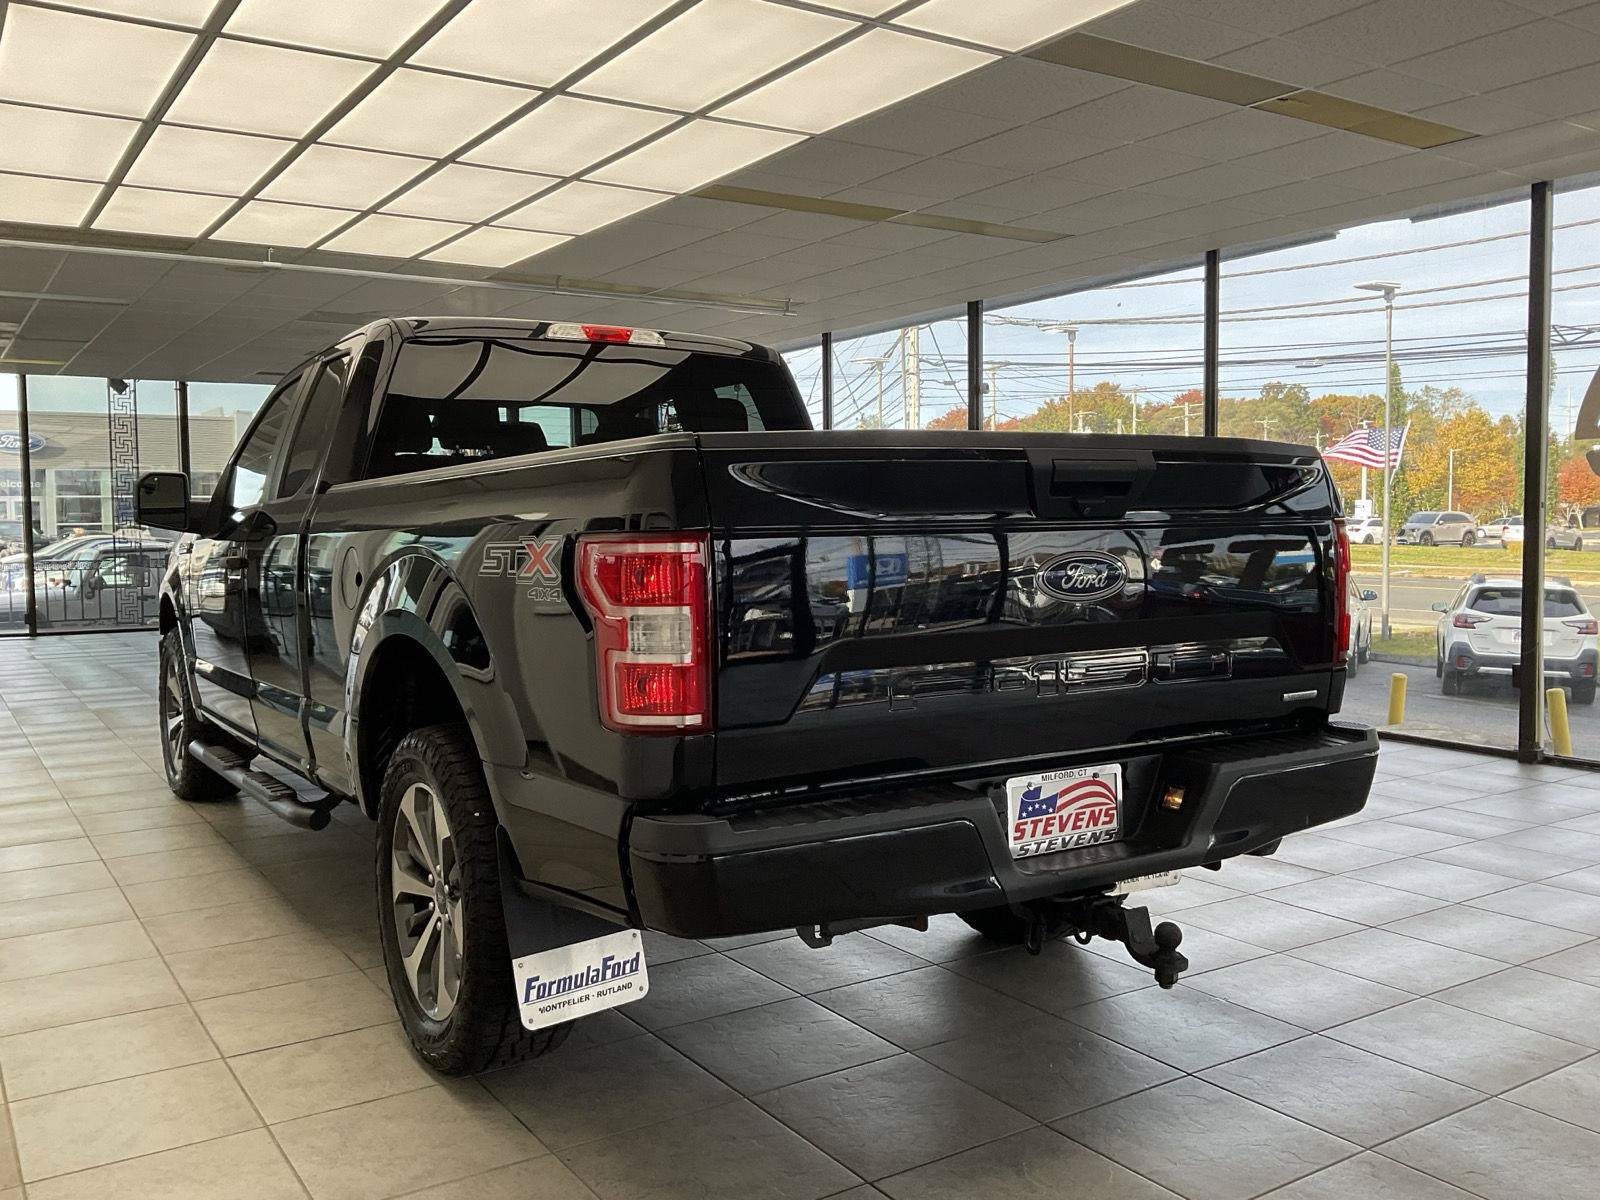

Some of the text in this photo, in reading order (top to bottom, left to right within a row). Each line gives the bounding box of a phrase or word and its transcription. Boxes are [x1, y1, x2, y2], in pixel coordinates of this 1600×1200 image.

[477, 535, 563, 586] STX
[1061, 562, 1109, 589] Ford
[1078, 769, 1088, 777] CT
[1013, 806, 1117, 841] STEVENS
[1017, 828, 1118, 857] STEVENS
[538, 981, 633, 1013] MONTPELIER RUTLAND
